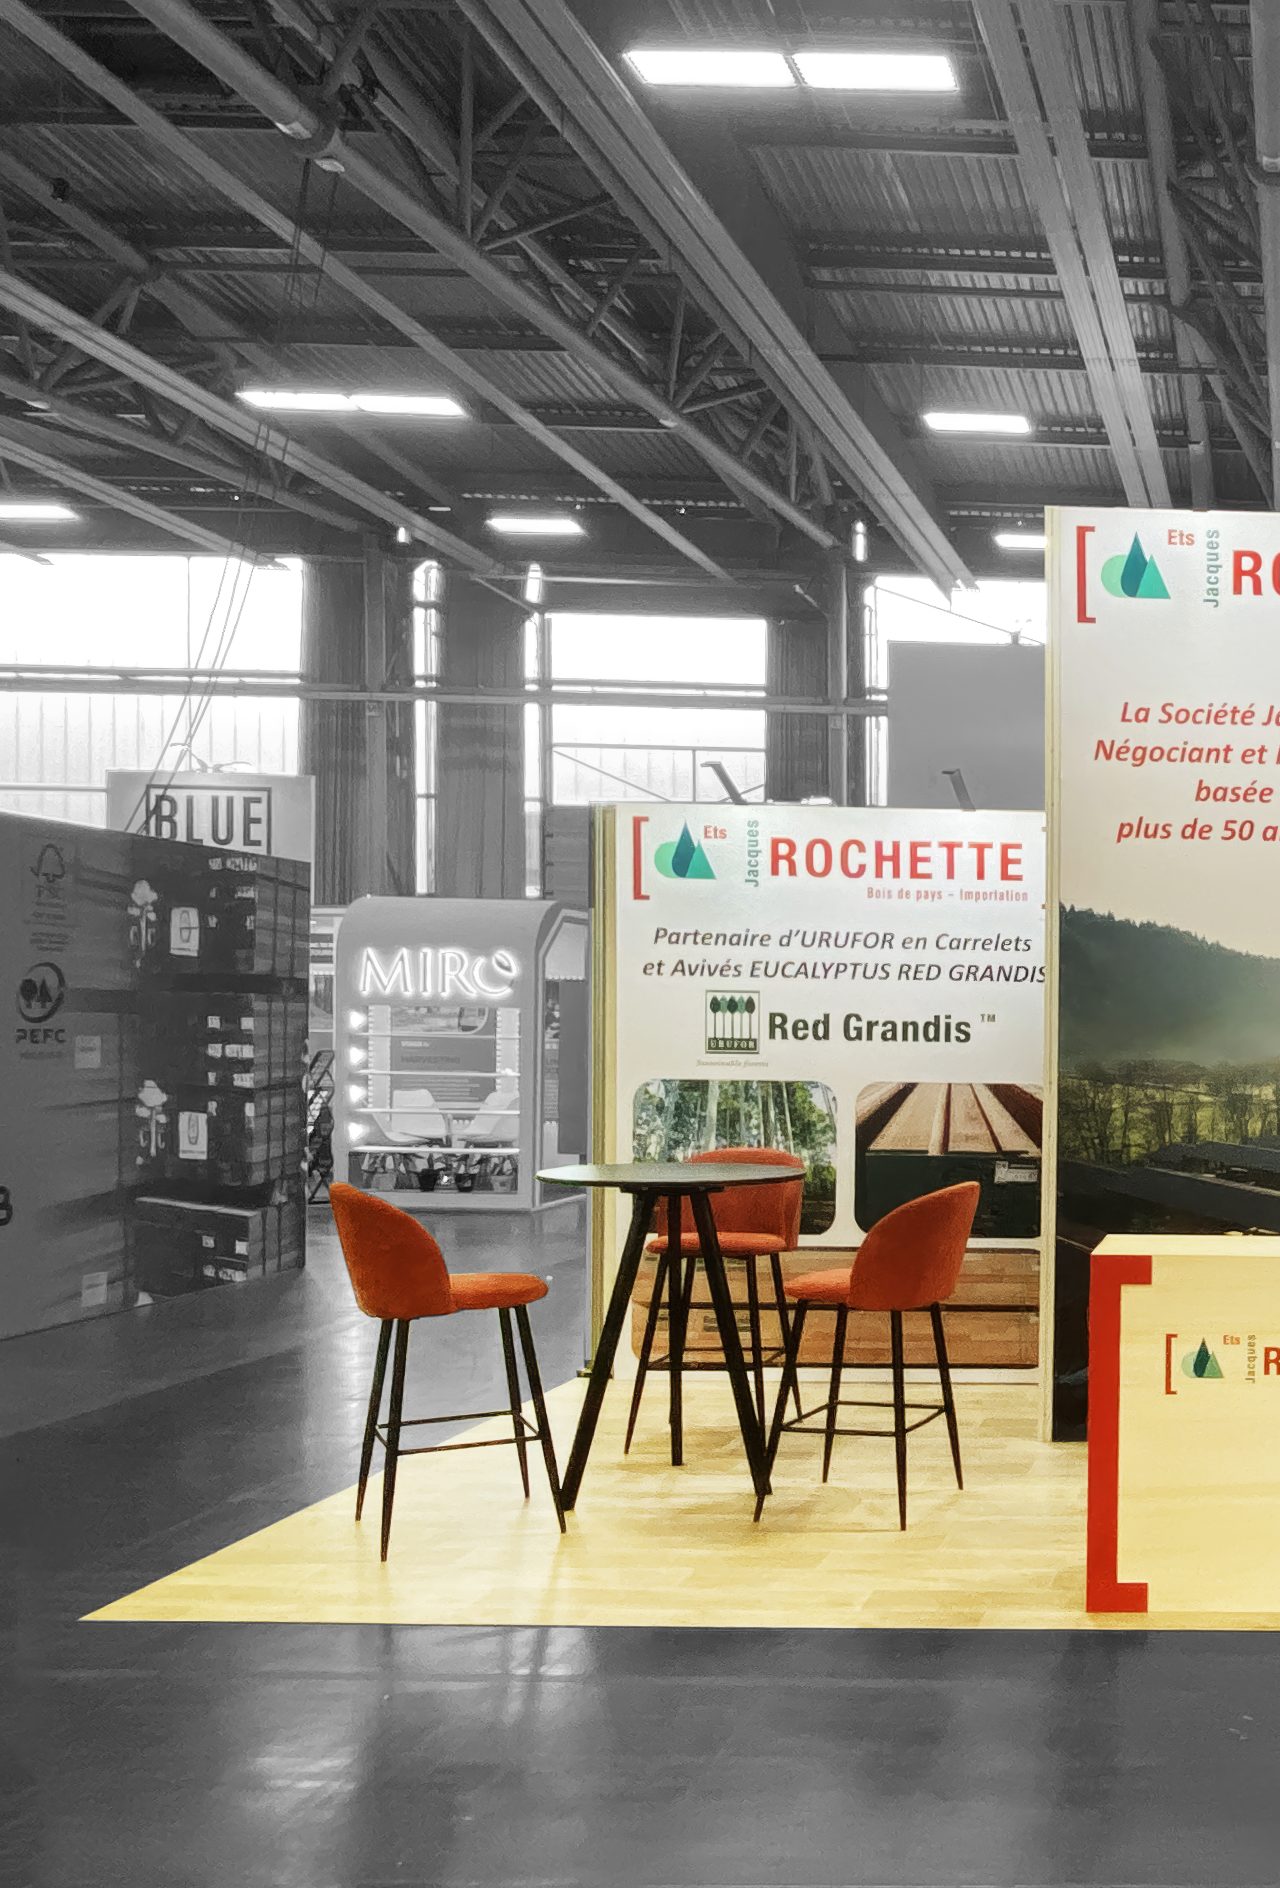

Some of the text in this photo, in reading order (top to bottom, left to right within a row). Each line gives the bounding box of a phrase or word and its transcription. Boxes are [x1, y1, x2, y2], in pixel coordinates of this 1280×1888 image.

[1168, 529, 1194, 546] Ets
[1203, 530, 1222, 608] Jacques
[1121, 702, 1150, 723] La
[1158, 703, 1255, 725] Société
[1094, 739, 1233, 767] Négociant
[1241, 745, 1267, 764] et
[1195, 779, 1273, 803] basée
[155, 795, 262, 846] BLUE
[704, 825, 727, 839] Ets
[1117, 816, 1172, 843] plus
[1181, 818, 1212, 840] de
[1221, 820, 1254, 841] 50
[745, 821, 762, 887] Jacques
[771, 838, 1023, 881] ROCHETTE
[867, 887, 892, 899] Bois
[898, 888, 911, 899] de
[916, 890, 942, 902] pays
[960, 889, 1027, 903] Importation
[654, 928, 771, 946] Partenaire
[902, 937, 927, 949] en
[936, 933, 1032, 951] Carrelets
[643, 959, 1047, 983] et Avivés EUCALYPTUS RED GRANDIS
[16, 1028, 66, 1044] PEFC
[769, 1013, 829, 1040] Red
[844, 1013, 970, 1043] Grandis
[1223, 1335, 1240, 1345] Ets
[1245, 1335, 1257, 1383] Jacques
